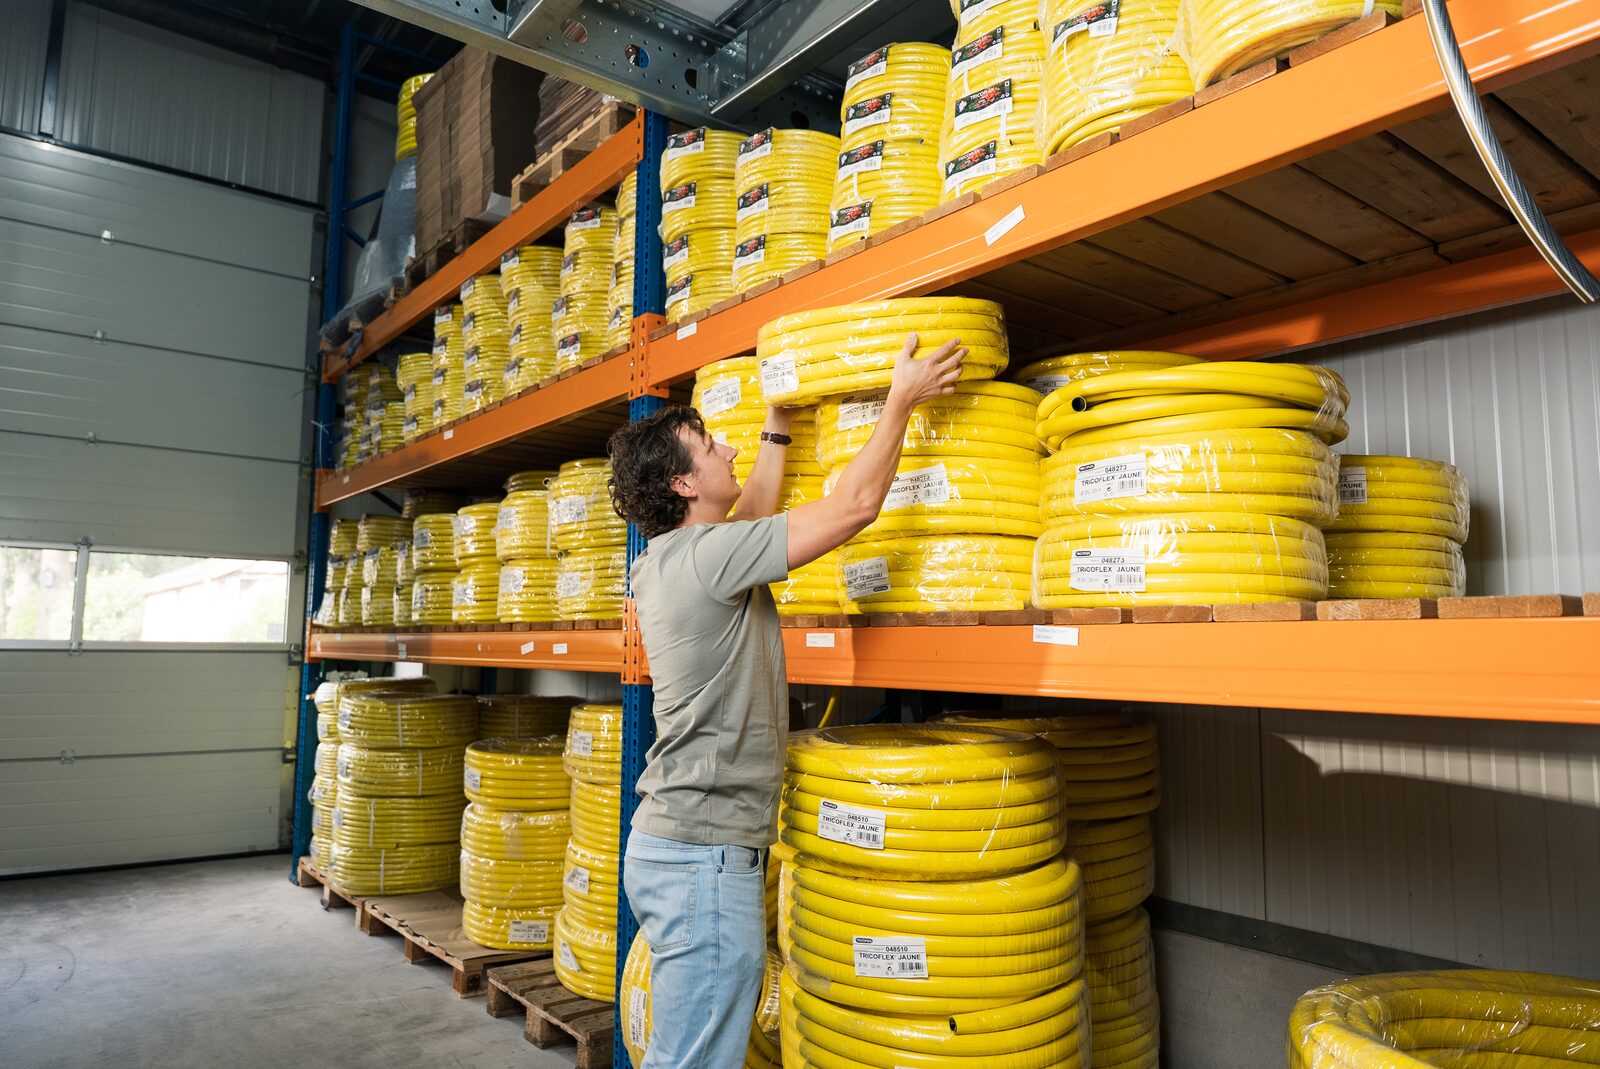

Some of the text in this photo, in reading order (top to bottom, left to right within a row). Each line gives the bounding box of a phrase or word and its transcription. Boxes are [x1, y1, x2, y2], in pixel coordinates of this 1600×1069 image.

[1105, 464, 1128, 473] 048273
[1081, 474, 1115, 486] TRICOFLEX
[822, 816, 855, 828] TRICOFLEX
[847, 814, 869, 823] 048510
